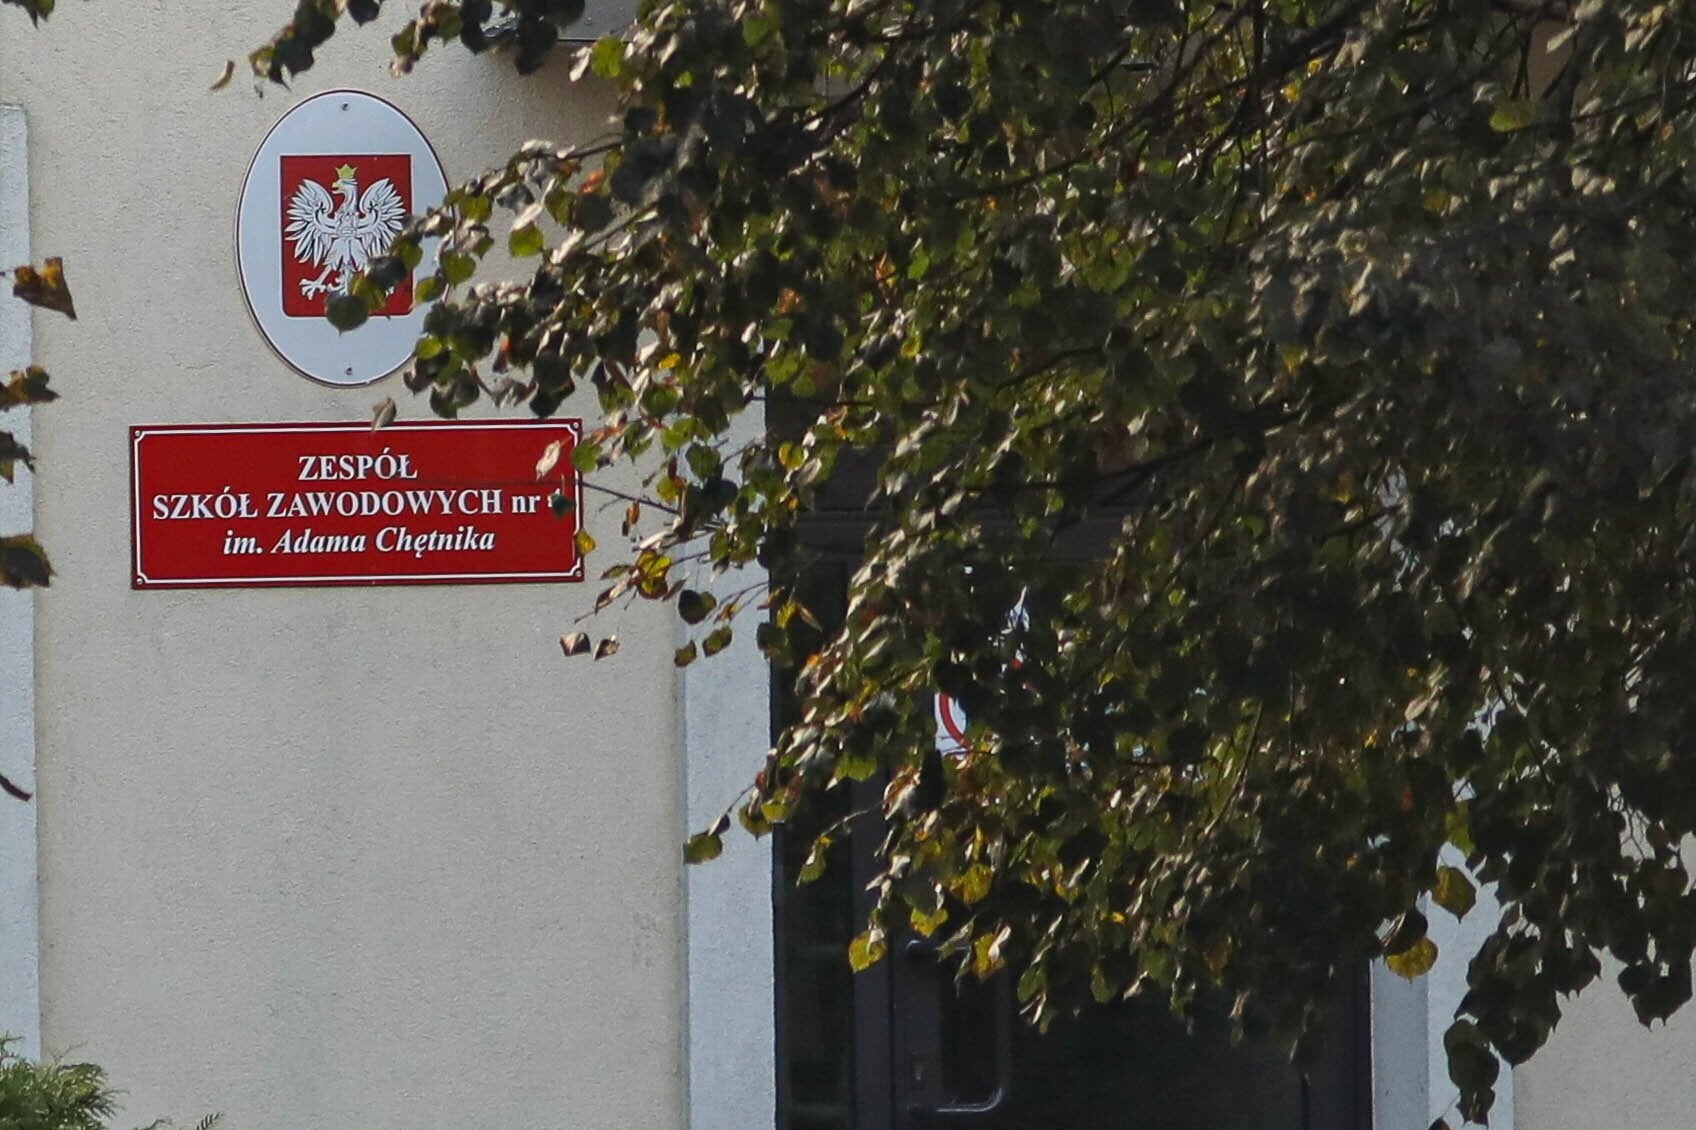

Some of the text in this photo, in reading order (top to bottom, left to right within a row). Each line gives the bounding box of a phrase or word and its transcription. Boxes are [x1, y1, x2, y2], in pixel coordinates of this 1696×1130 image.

[298, 447, 417, 481] ZESPÓŁ
[152, 486, 258, 520] SZKÓŁ
[266, 488, 503, 518] ZAWODOWYCH
[511, 494, 541, 514] nr
[223, 526, 496, 559] im. Adama Chętnika
